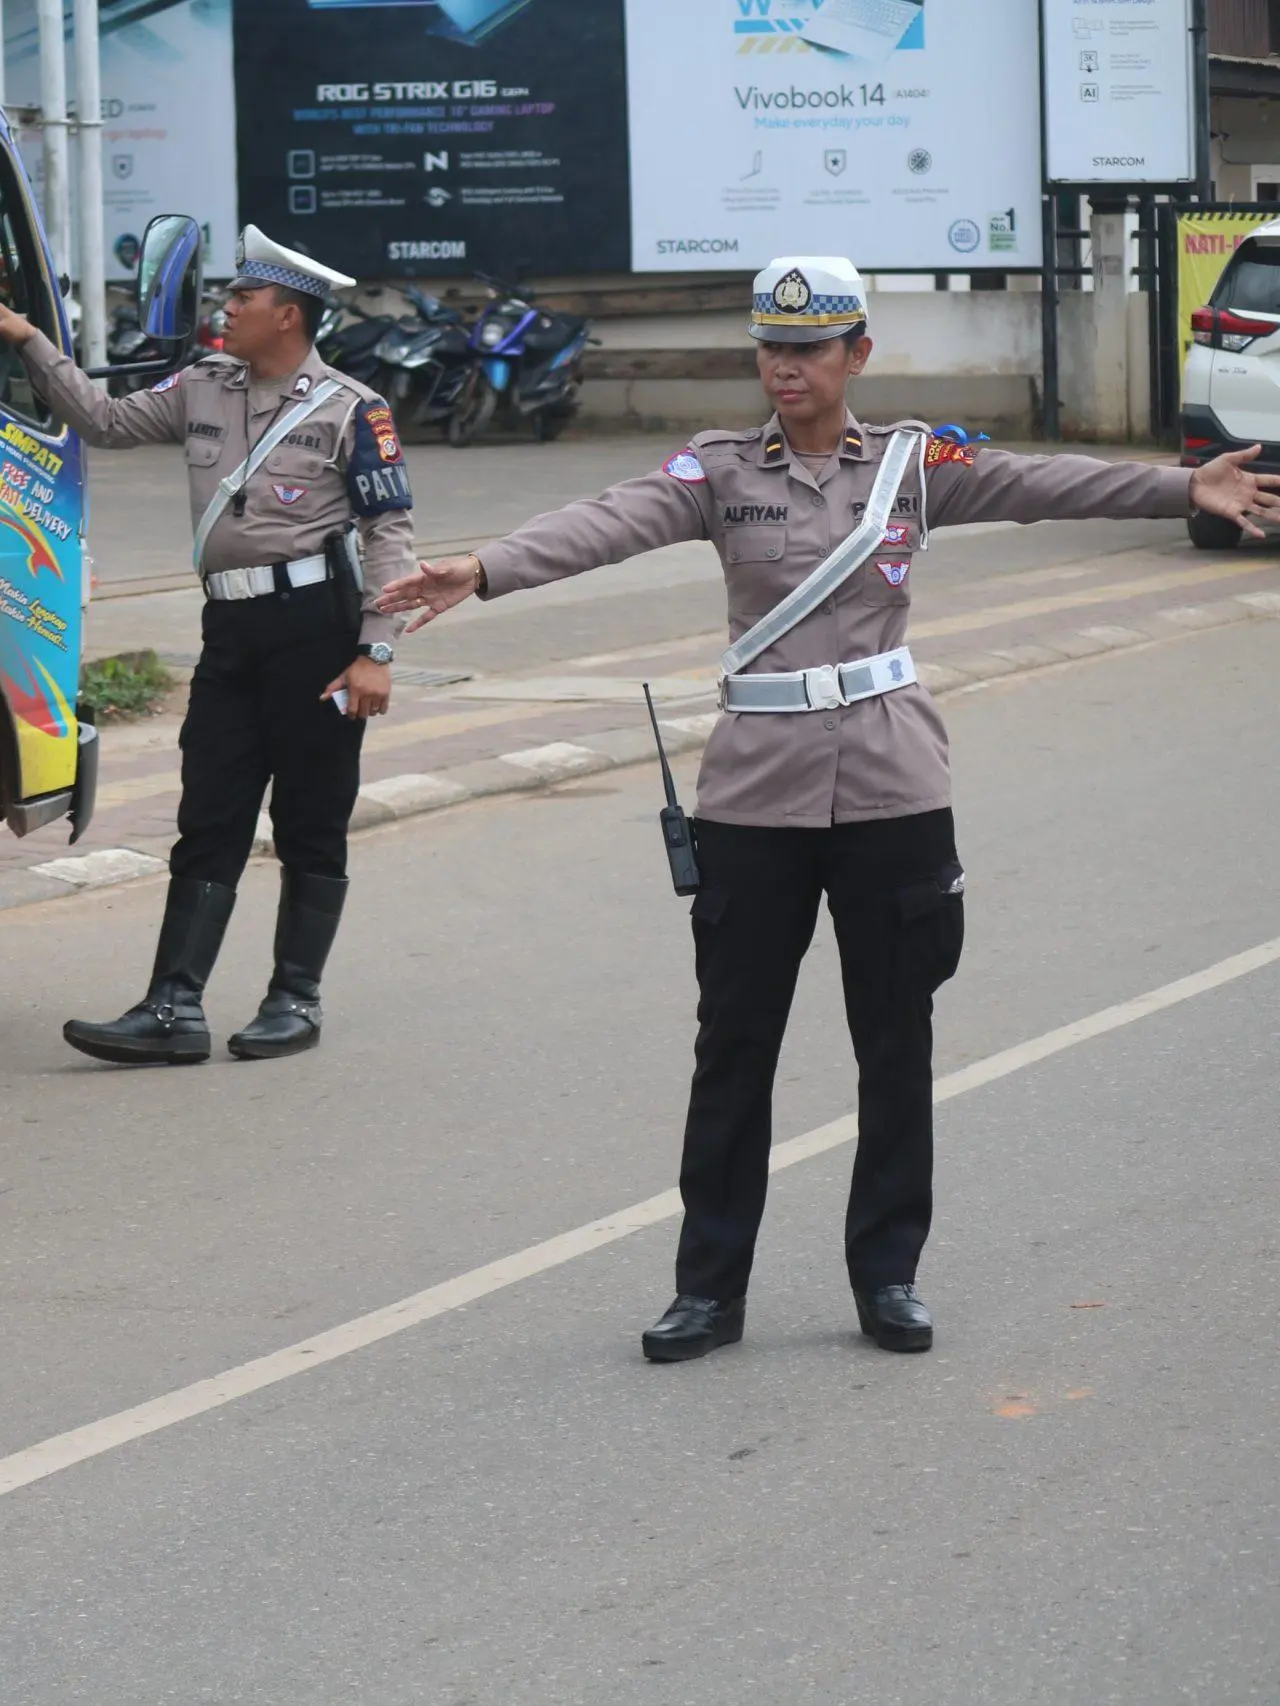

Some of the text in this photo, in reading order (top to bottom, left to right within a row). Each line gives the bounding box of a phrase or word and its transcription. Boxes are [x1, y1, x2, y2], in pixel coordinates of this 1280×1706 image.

[316, 83, 369, 101] ROG
[373, 82, 449, 100] STRIX
[452, 80, 496, 98] G16
[734, 83, 854, 110] Vivobook
[859, 83, 887, 107] 14
[854, 117, 883, 130] your
[887, 115, 910, 128] day
[1092, 156, 1145, 167] STARCOM
[388, 241, 467, 259] STARCOM
[657, 239, 739, 255] STARCOM
[0, 461, 54, 503] FREE AND
[22, 498, 72, 542] DELIVERY
[723, 505, 788, 522] ALFIYAH
